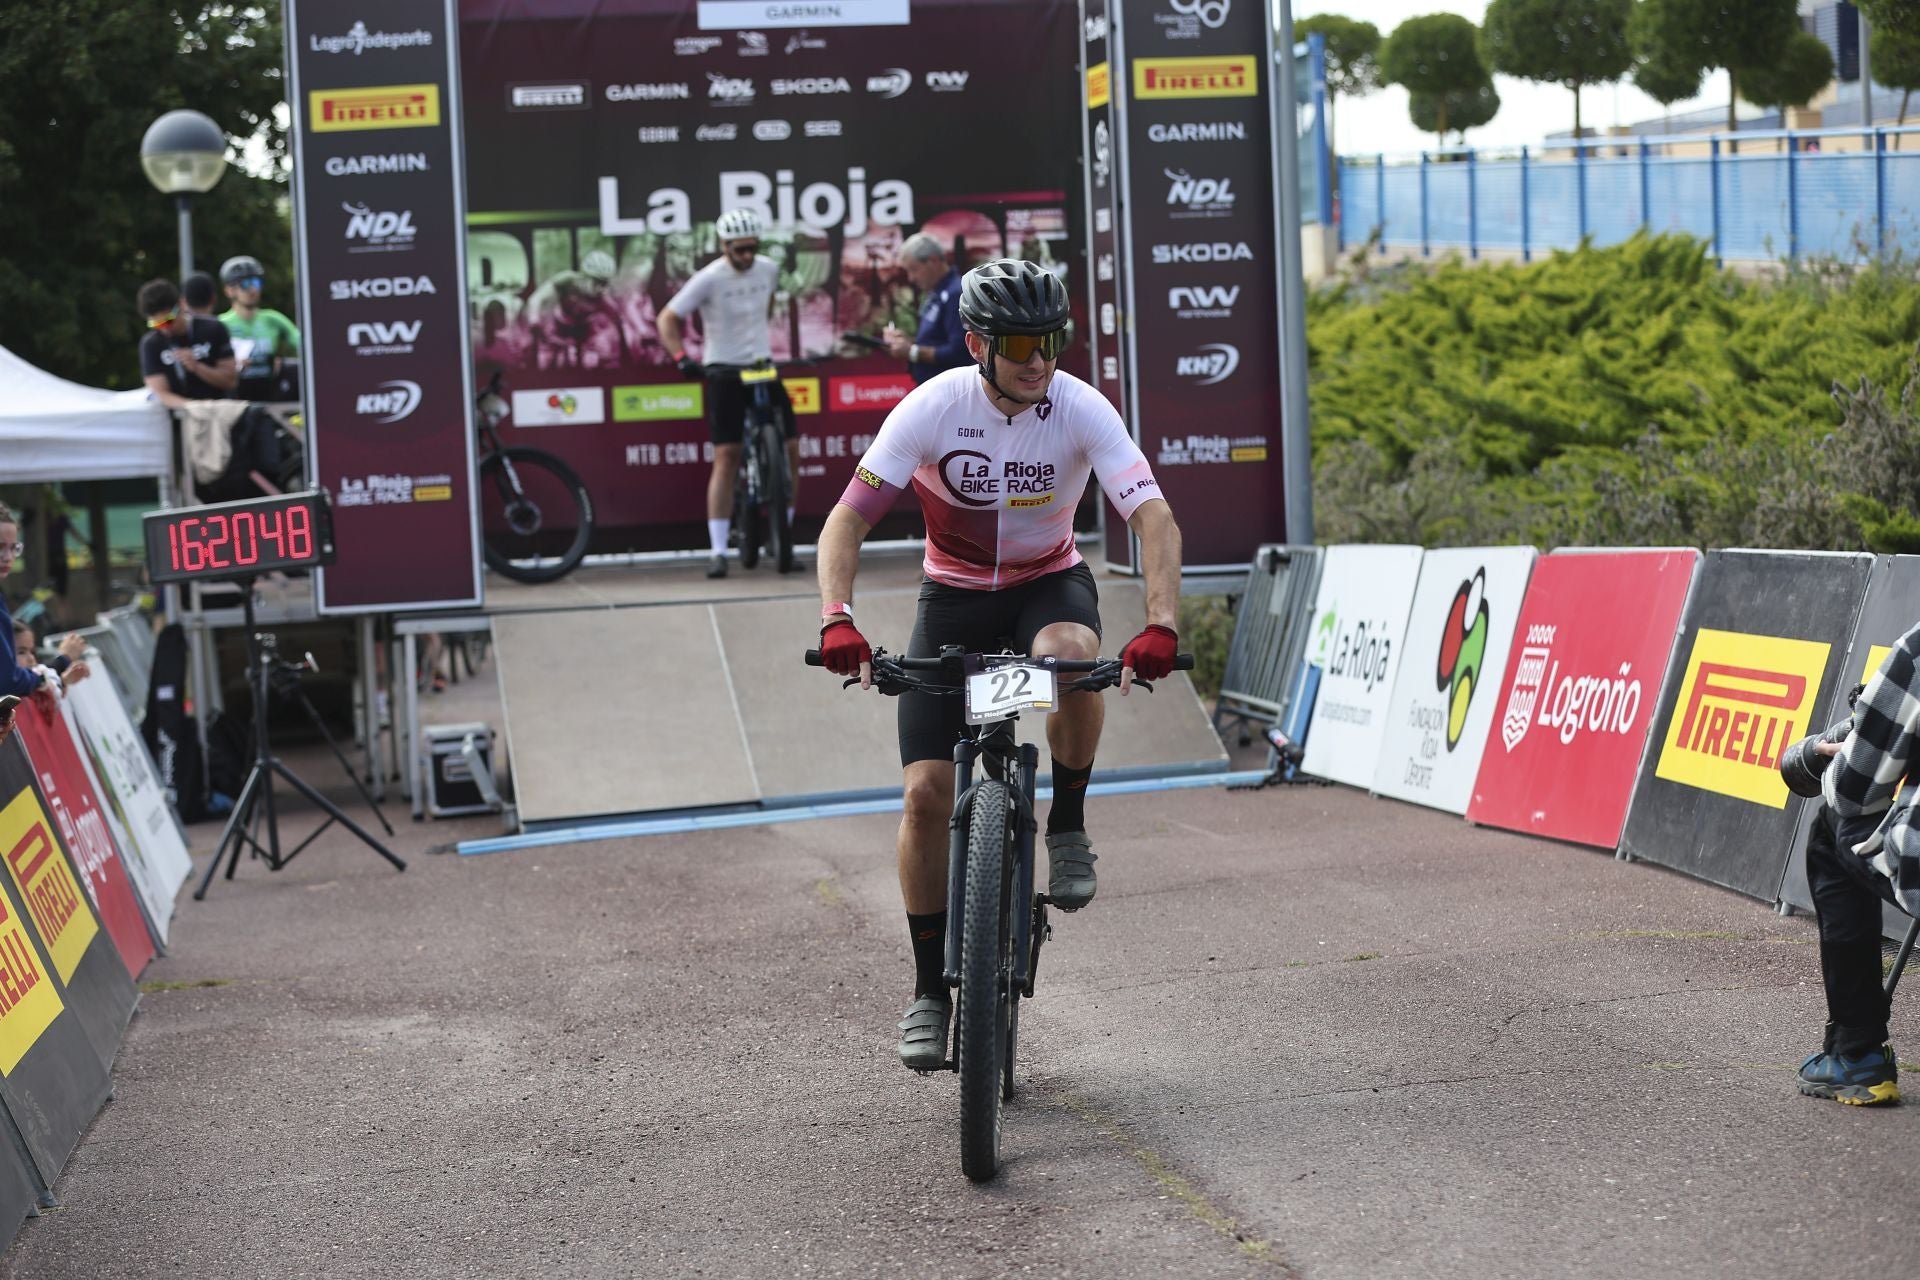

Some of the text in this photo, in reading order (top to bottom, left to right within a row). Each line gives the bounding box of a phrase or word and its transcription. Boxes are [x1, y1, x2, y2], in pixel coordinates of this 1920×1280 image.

[1144, 65, 1246, 90] PIRELLI
[606, 82, 689, 101] GARMIN
[322, 95, 427, 122] PIRELLI
[1148, 122, 1245, 142] GARMIN
[325, 152, 428, 176] GARMIN
[600, 166, 916, 239] La Rioja
[1166, 177, 1235, 204] NDL
[345, 210, 418, 239] NDL
[957, 427, 985, 438] GOBIK
[625, 444, 661, 466] MTB
[665, 442, 698, 465] CON
[860, 468, 882, 483] RACE
[962, 461, 1055, 481] La Rioja
[960, 477, 1055, 493] BIKE RACE
[1119, 487, 1135, 500] La
[1329, 617, 1391, 693] La Rioja
[990, 668, 1032, 704] 22
[1537, 660, 1641, 745] Logroño
[1675, 661, 1807, 772] PIRELLI
[8, 820, 79, 949] PIRELLI
